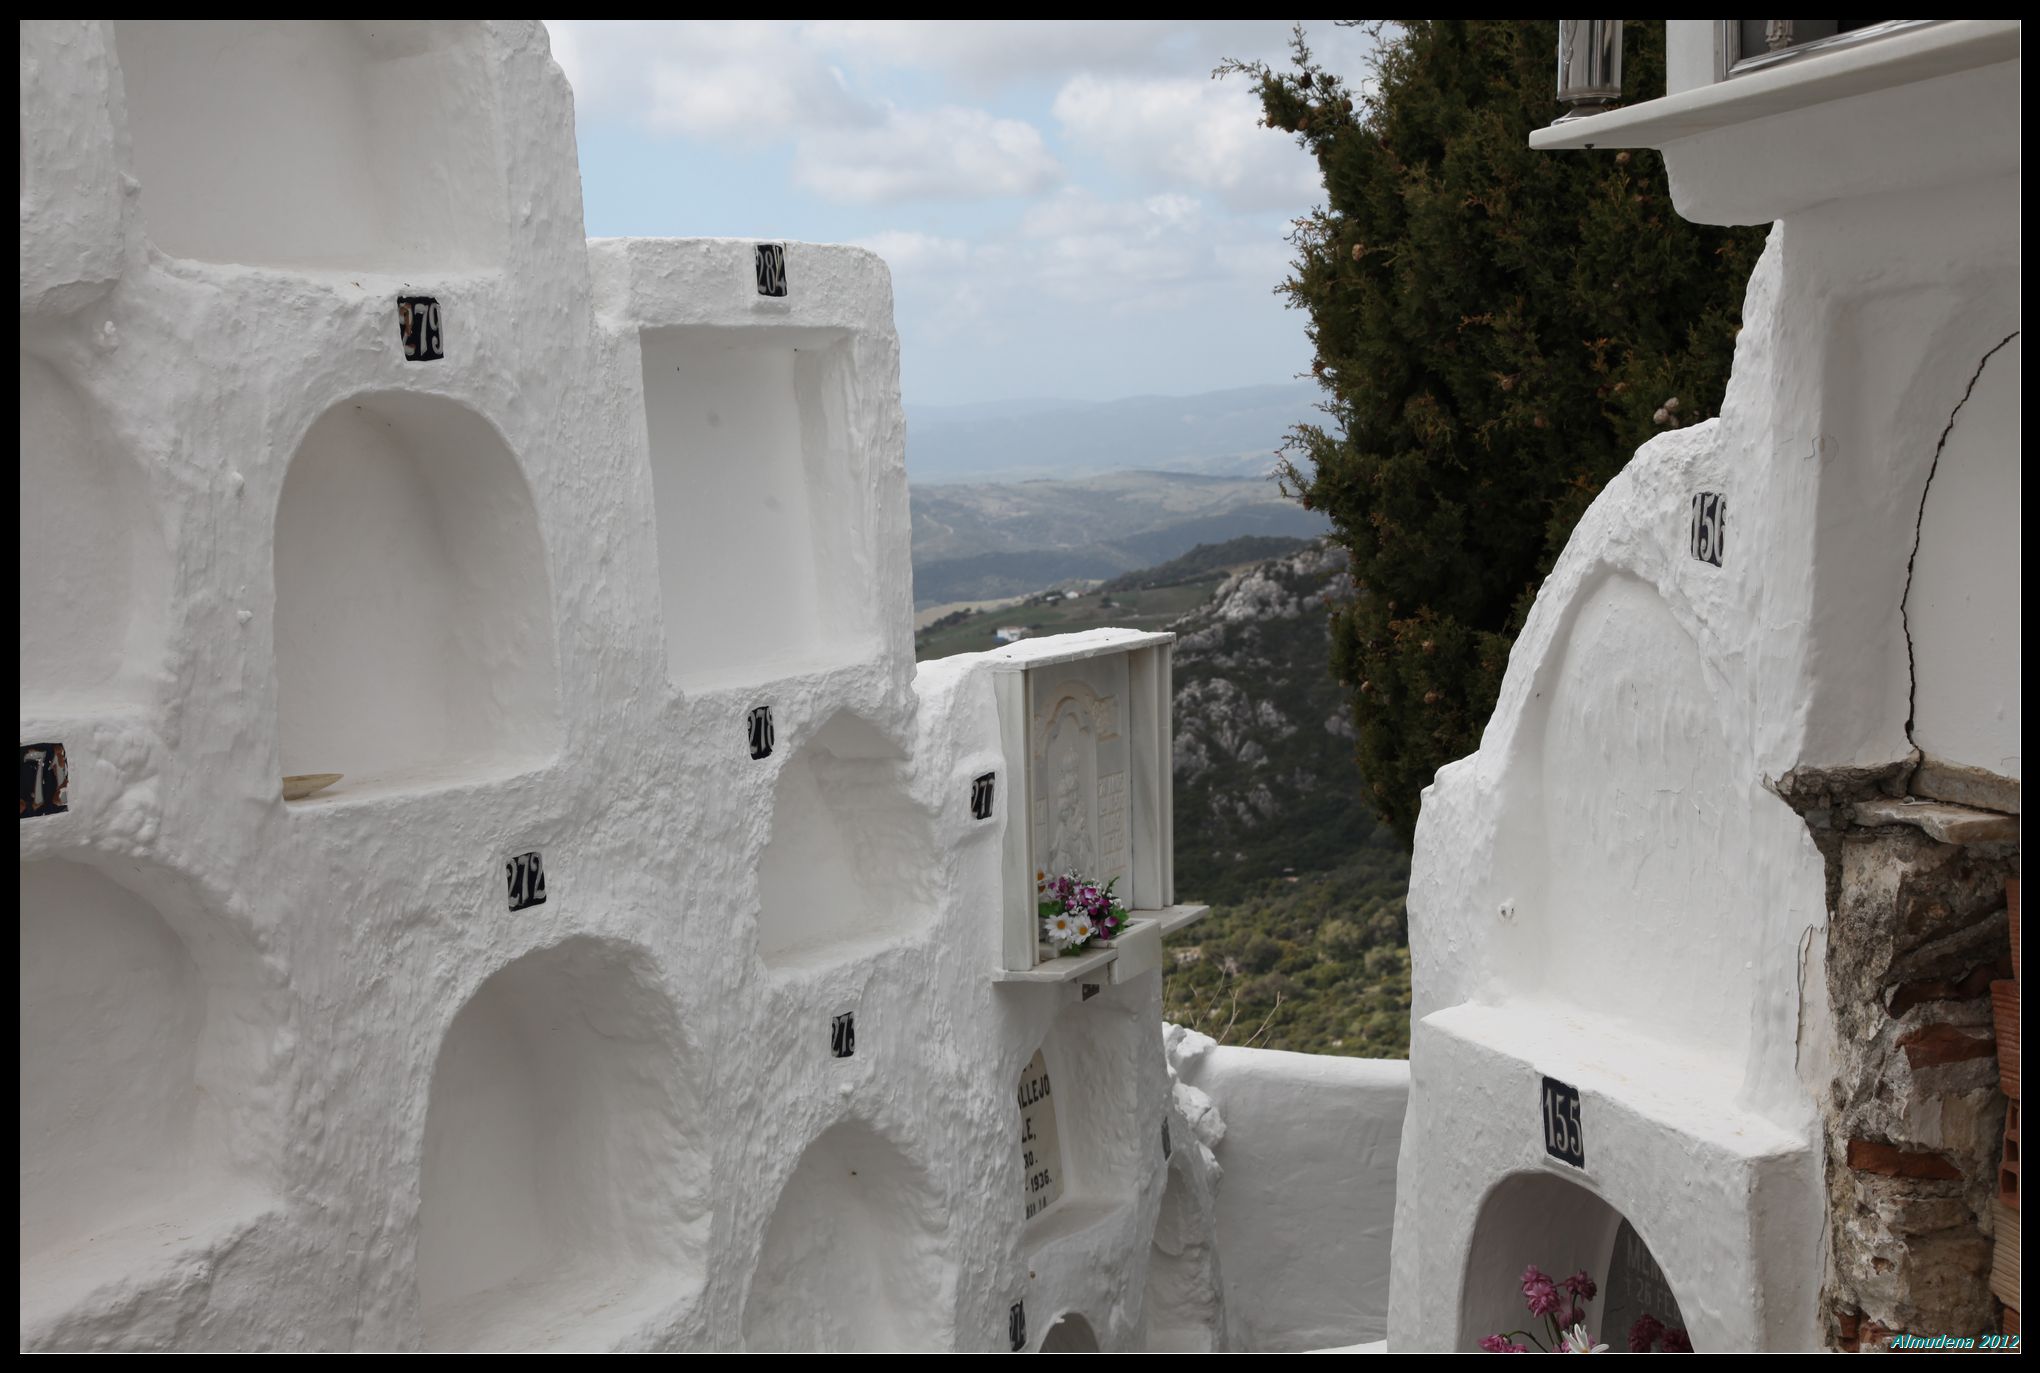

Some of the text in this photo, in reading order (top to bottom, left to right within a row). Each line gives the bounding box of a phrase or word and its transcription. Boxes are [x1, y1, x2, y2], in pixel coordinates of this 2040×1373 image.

[399, 302, 444, 357] 279
[1687, 492, 1726, 563] 156
[971, 778, 995, 818] 277
[506, 853, 545, 907] 272
[1544, 1087, 1582, 1156] 155
